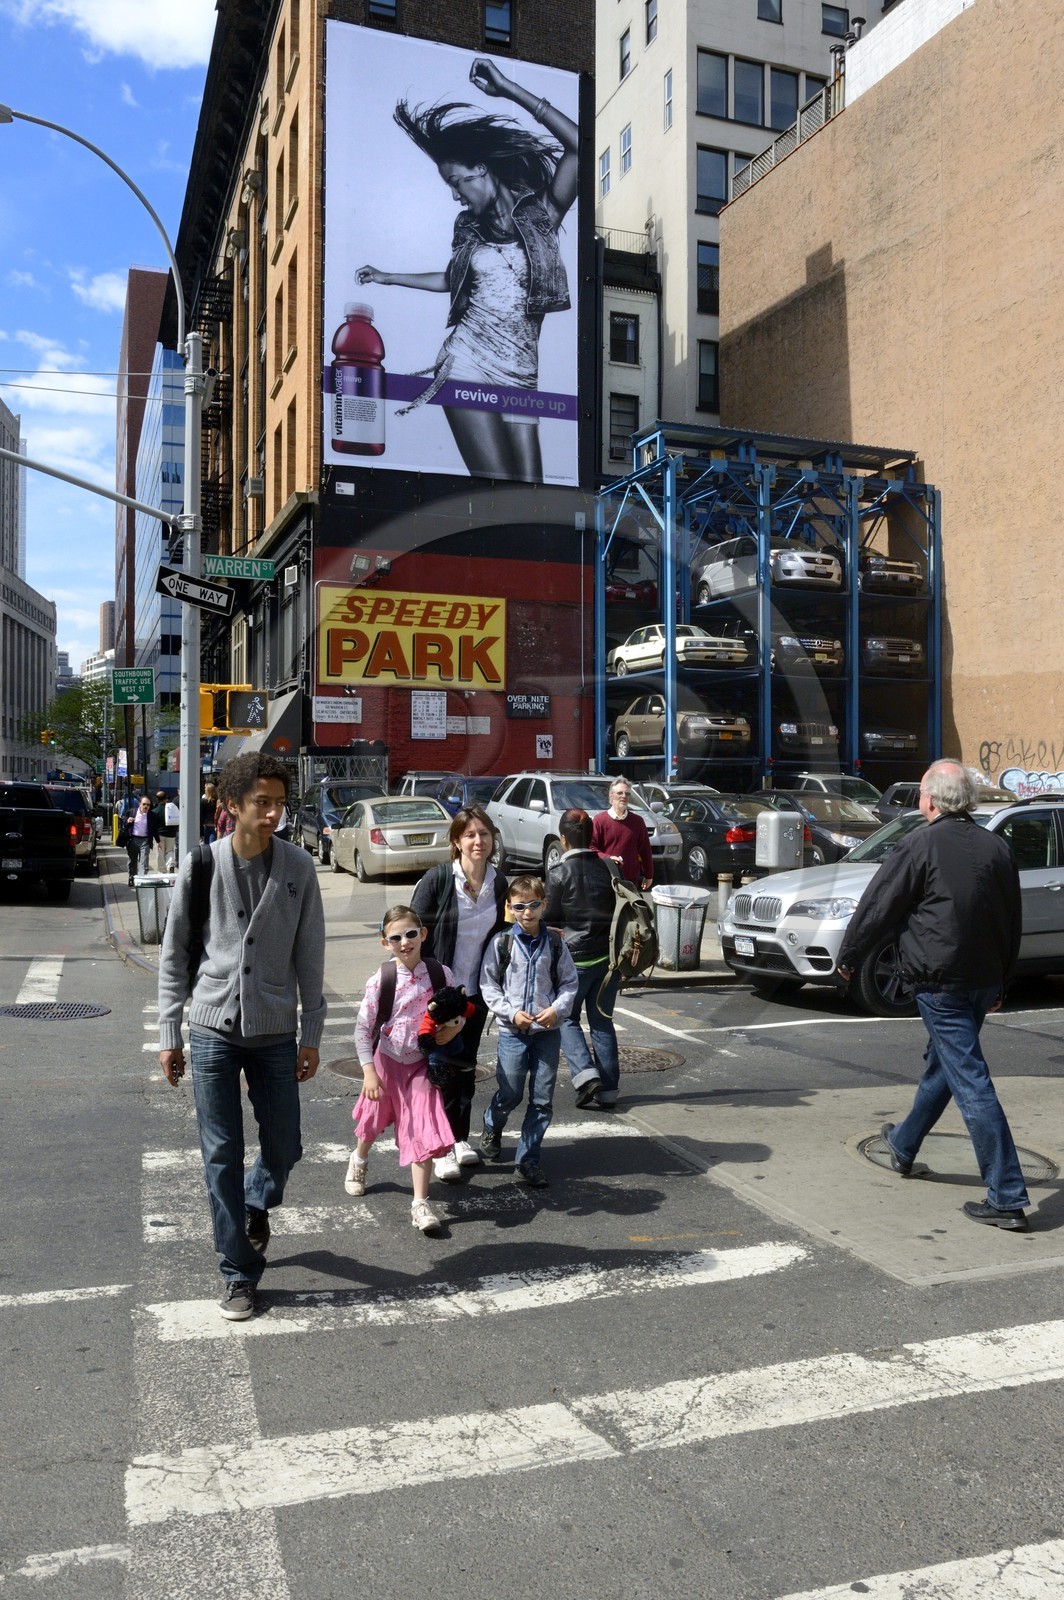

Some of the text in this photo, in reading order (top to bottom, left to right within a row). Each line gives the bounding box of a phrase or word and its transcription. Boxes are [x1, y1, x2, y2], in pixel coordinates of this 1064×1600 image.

[335, 368, 343, 435] vitaminwater
[454, 388, 566, 414] revive you're up
[205, 556, 273, 577] WARREN ST
[168, 577, 224, 604] ONE WAY
[340, 595, 500, 630] SPEEDY
[327, 628, 501, 683] PARK
[114, 670, 151, 678] SOUTHBOUND
[139, 677, 151, 685] USE
[121, 685, 145, 693] WEST ST
[507, 695, 550, 703] OVER NITE
[512, 702, 545, 710] PARKING
